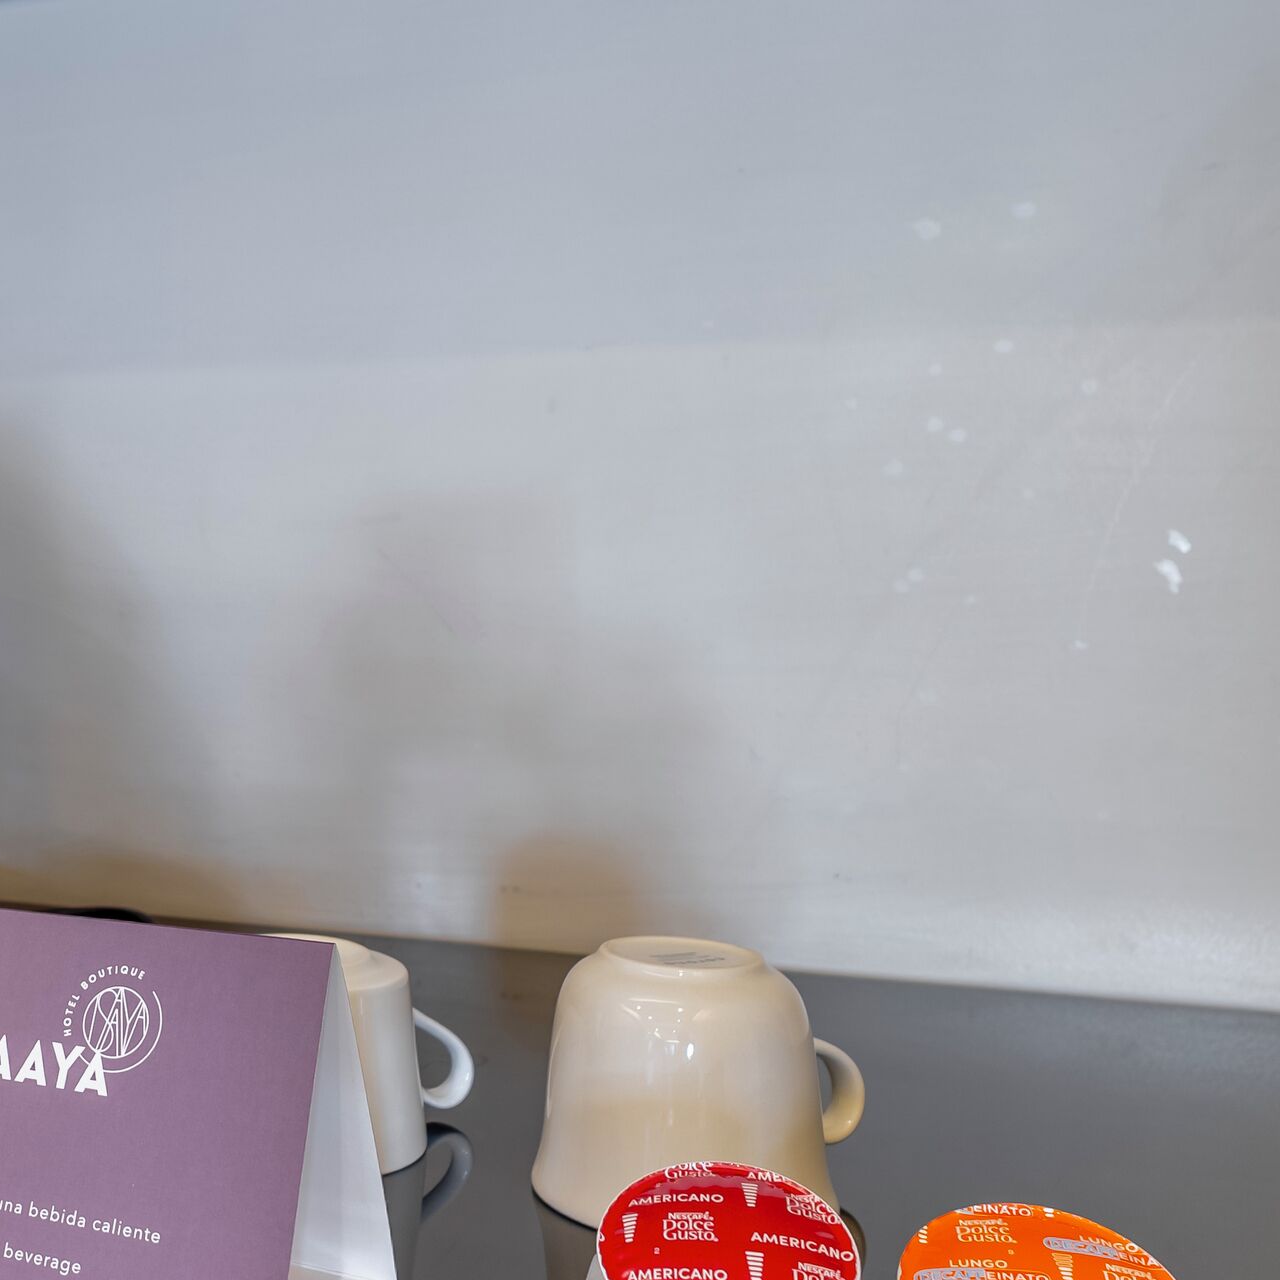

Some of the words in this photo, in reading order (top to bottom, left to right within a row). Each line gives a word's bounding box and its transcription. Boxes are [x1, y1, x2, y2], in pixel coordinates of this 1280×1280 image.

[63, 994, 81, 1037] HOTEL
[80, 965, 146, 990] BOUTIQUE
[628, 1193, 724, 1208] AMERICANO
[28, 1201, 86, 1228] bebida
[92, 1218, 161, 1244] caliente
[662, 1219, 715, 1231] Dolce
[956, 1224, 1010, 1236] Dolce
[662, 1229, 716, 1241] Gusto
[957, 1232, 1014, 1243] Gusto
[750, 1231, 854, 1262] AMERICANO
[1079, 1235, 1141, 1253] LUNGO
[3, 1242, 82, 1276] beverage
[948, 1259, 1009, 1268] LUNGO
